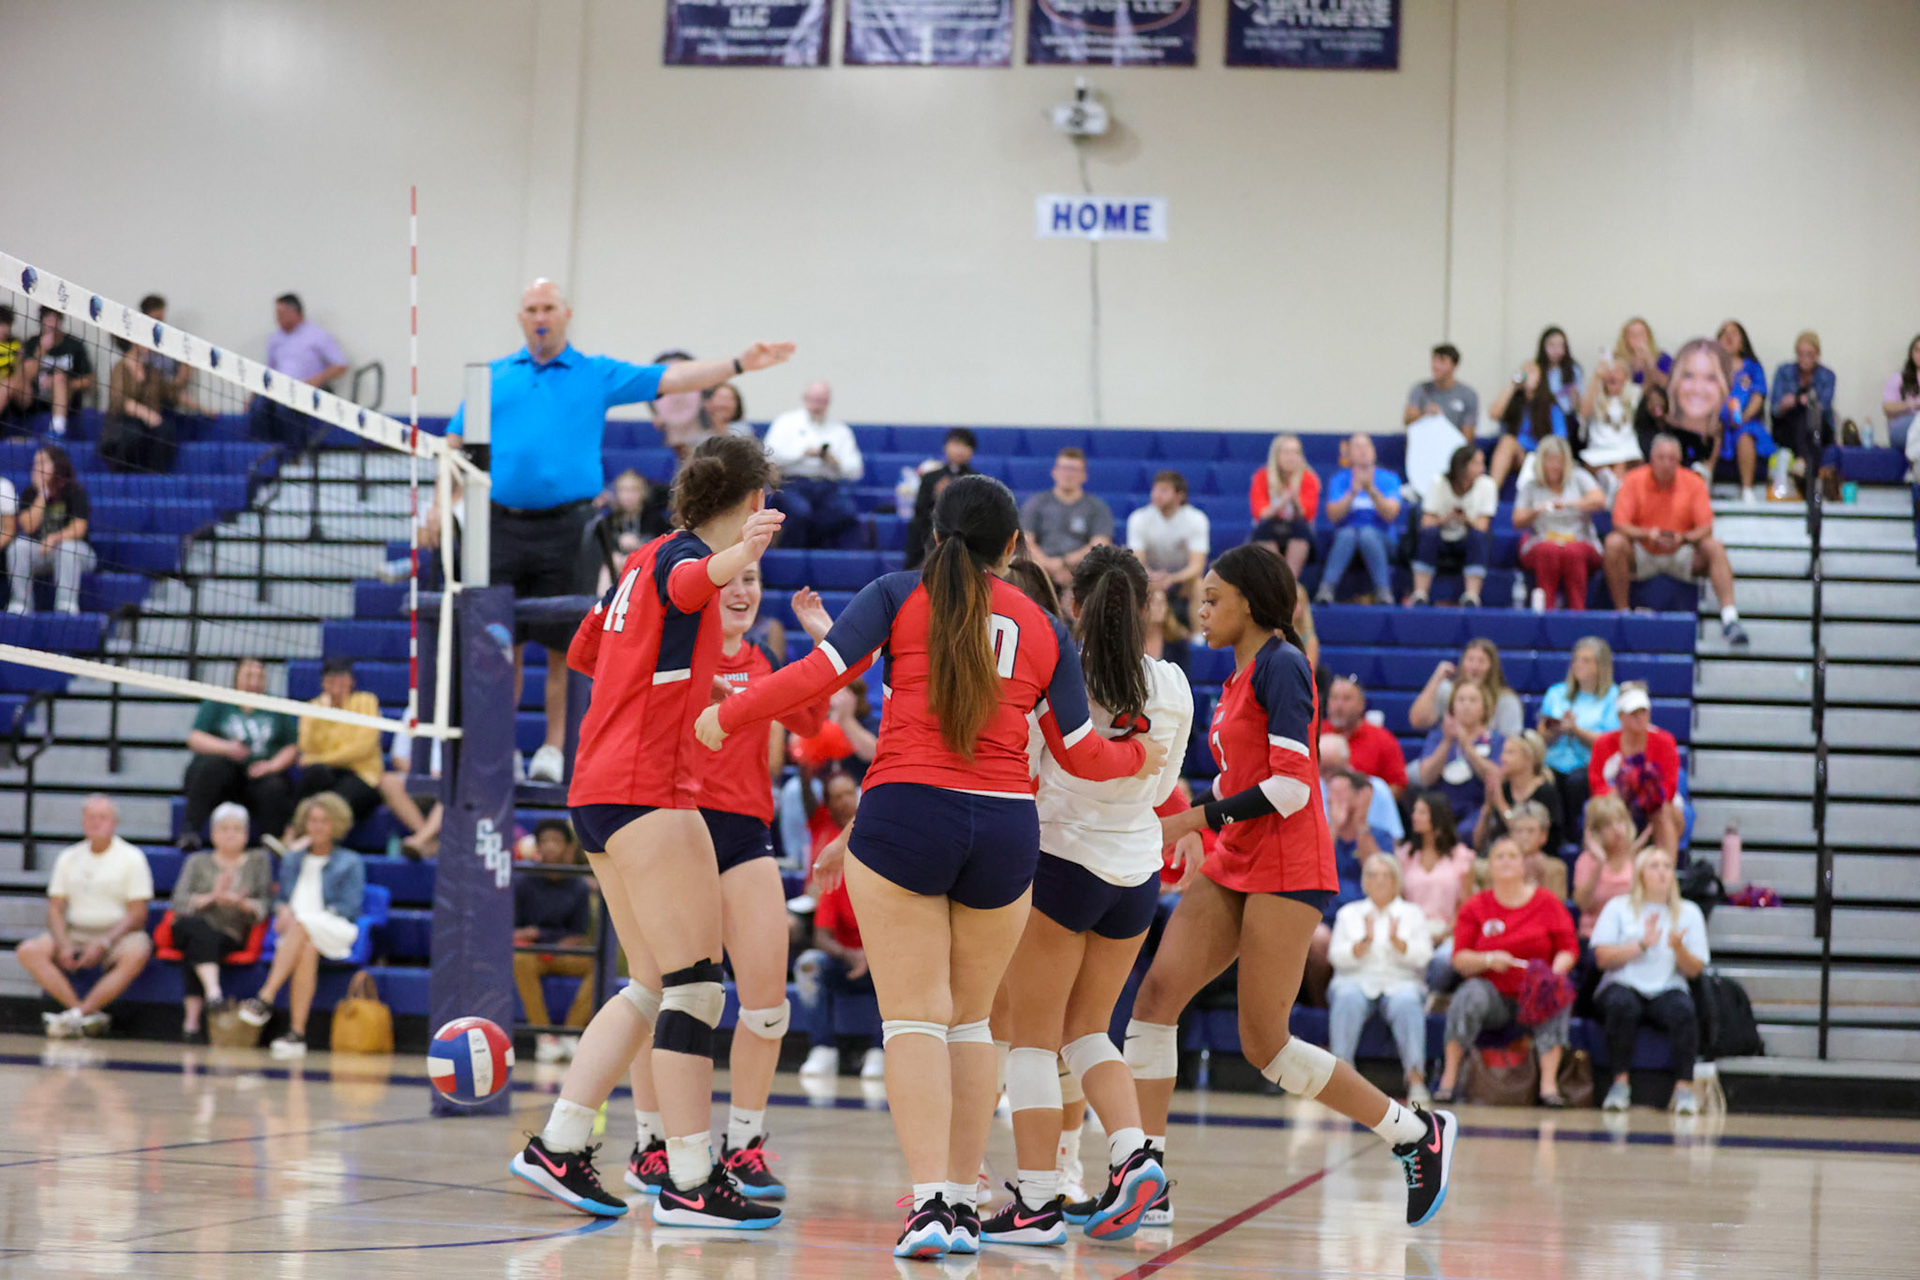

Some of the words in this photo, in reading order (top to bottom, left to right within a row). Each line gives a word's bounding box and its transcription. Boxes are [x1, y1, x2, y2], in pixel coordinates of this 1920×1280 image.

[1268, 10, 1391, 27] FITNESS
[1053, 204, 1151, 231] HOME
[603, 567, 642, 633] 14
